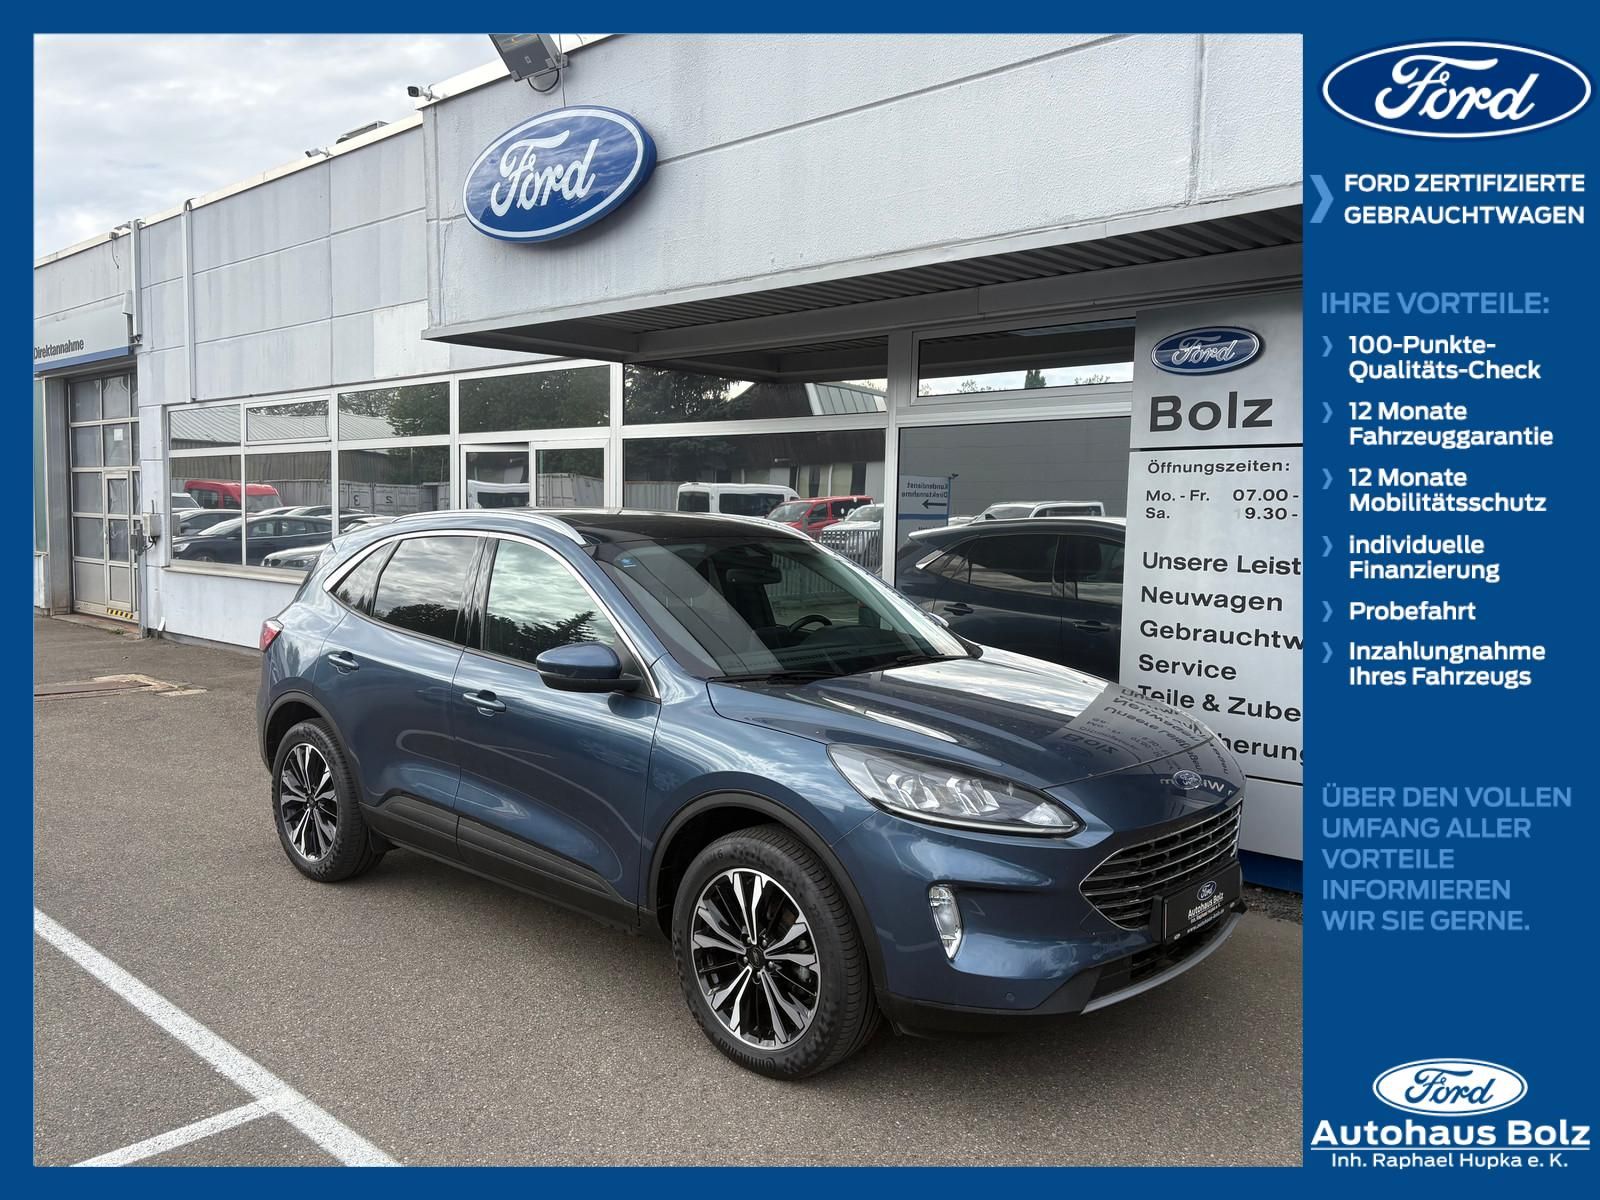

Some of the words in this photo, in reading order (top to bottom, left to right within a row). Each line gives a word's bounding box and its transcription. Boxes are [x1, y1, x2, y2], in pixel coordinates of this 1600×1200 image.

[490, 129, 600, 217] Ford
[33, 338, 85, 359] Direktannahme
[1171, 335, 1238, 366] Ford
[1150, 391, 1273, 433] Bolz
[1147, 459, 1291, 476] Öffnungszeiten:
[1145, 489, 1176, 502] Mo.
[1189, 489, 1210, 502] Fr.
[1232, 488, 1289, 502] 07.00
[1145, 507, 1170, 519] Sa.
[1244, 507, 1288, 520] 9.30
[1142, 551, 1228, 573] Unsere
[1237, 555, 1302, 576] Leist
[1140, 585, 1284, 614] Neuwagen
[1139, 619, 1303, 650] Gebrauchtw
[1138, 653, 1237, 681] Service
[1137, 684, 1195, 709] Teile
[1201, 693, 1221, 713] &
[1227, 695, 1301, 722] Zube
